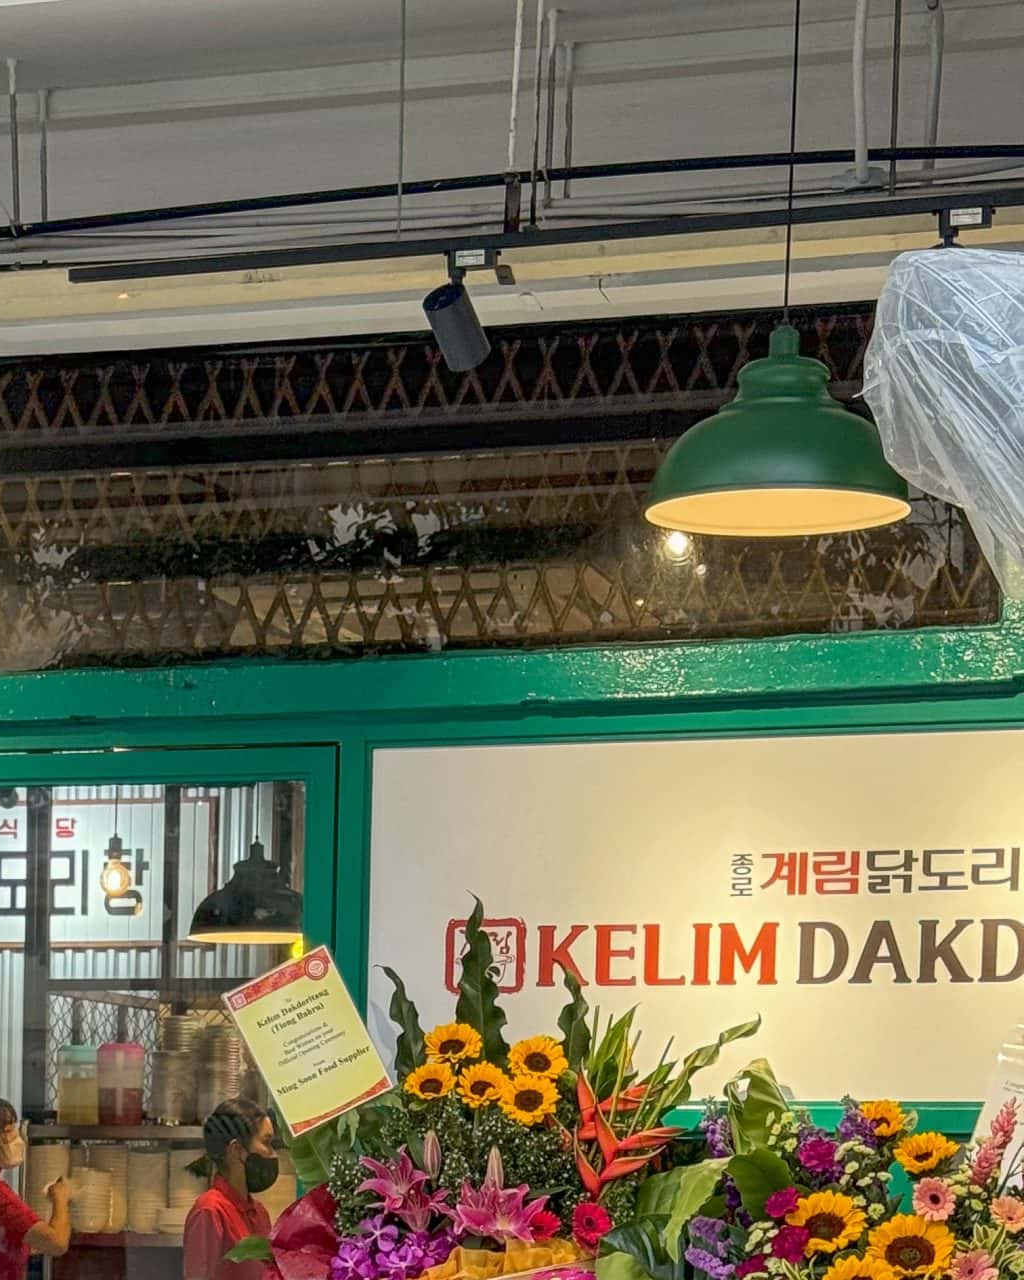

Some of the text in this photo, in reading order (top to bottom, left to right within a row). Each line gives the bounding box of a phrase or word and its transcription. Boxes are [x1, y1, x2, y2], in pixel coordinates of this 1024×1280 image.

[730, 853, 754, 897] 종로
[536, 918, 1024, 986] KELIM DAKD
